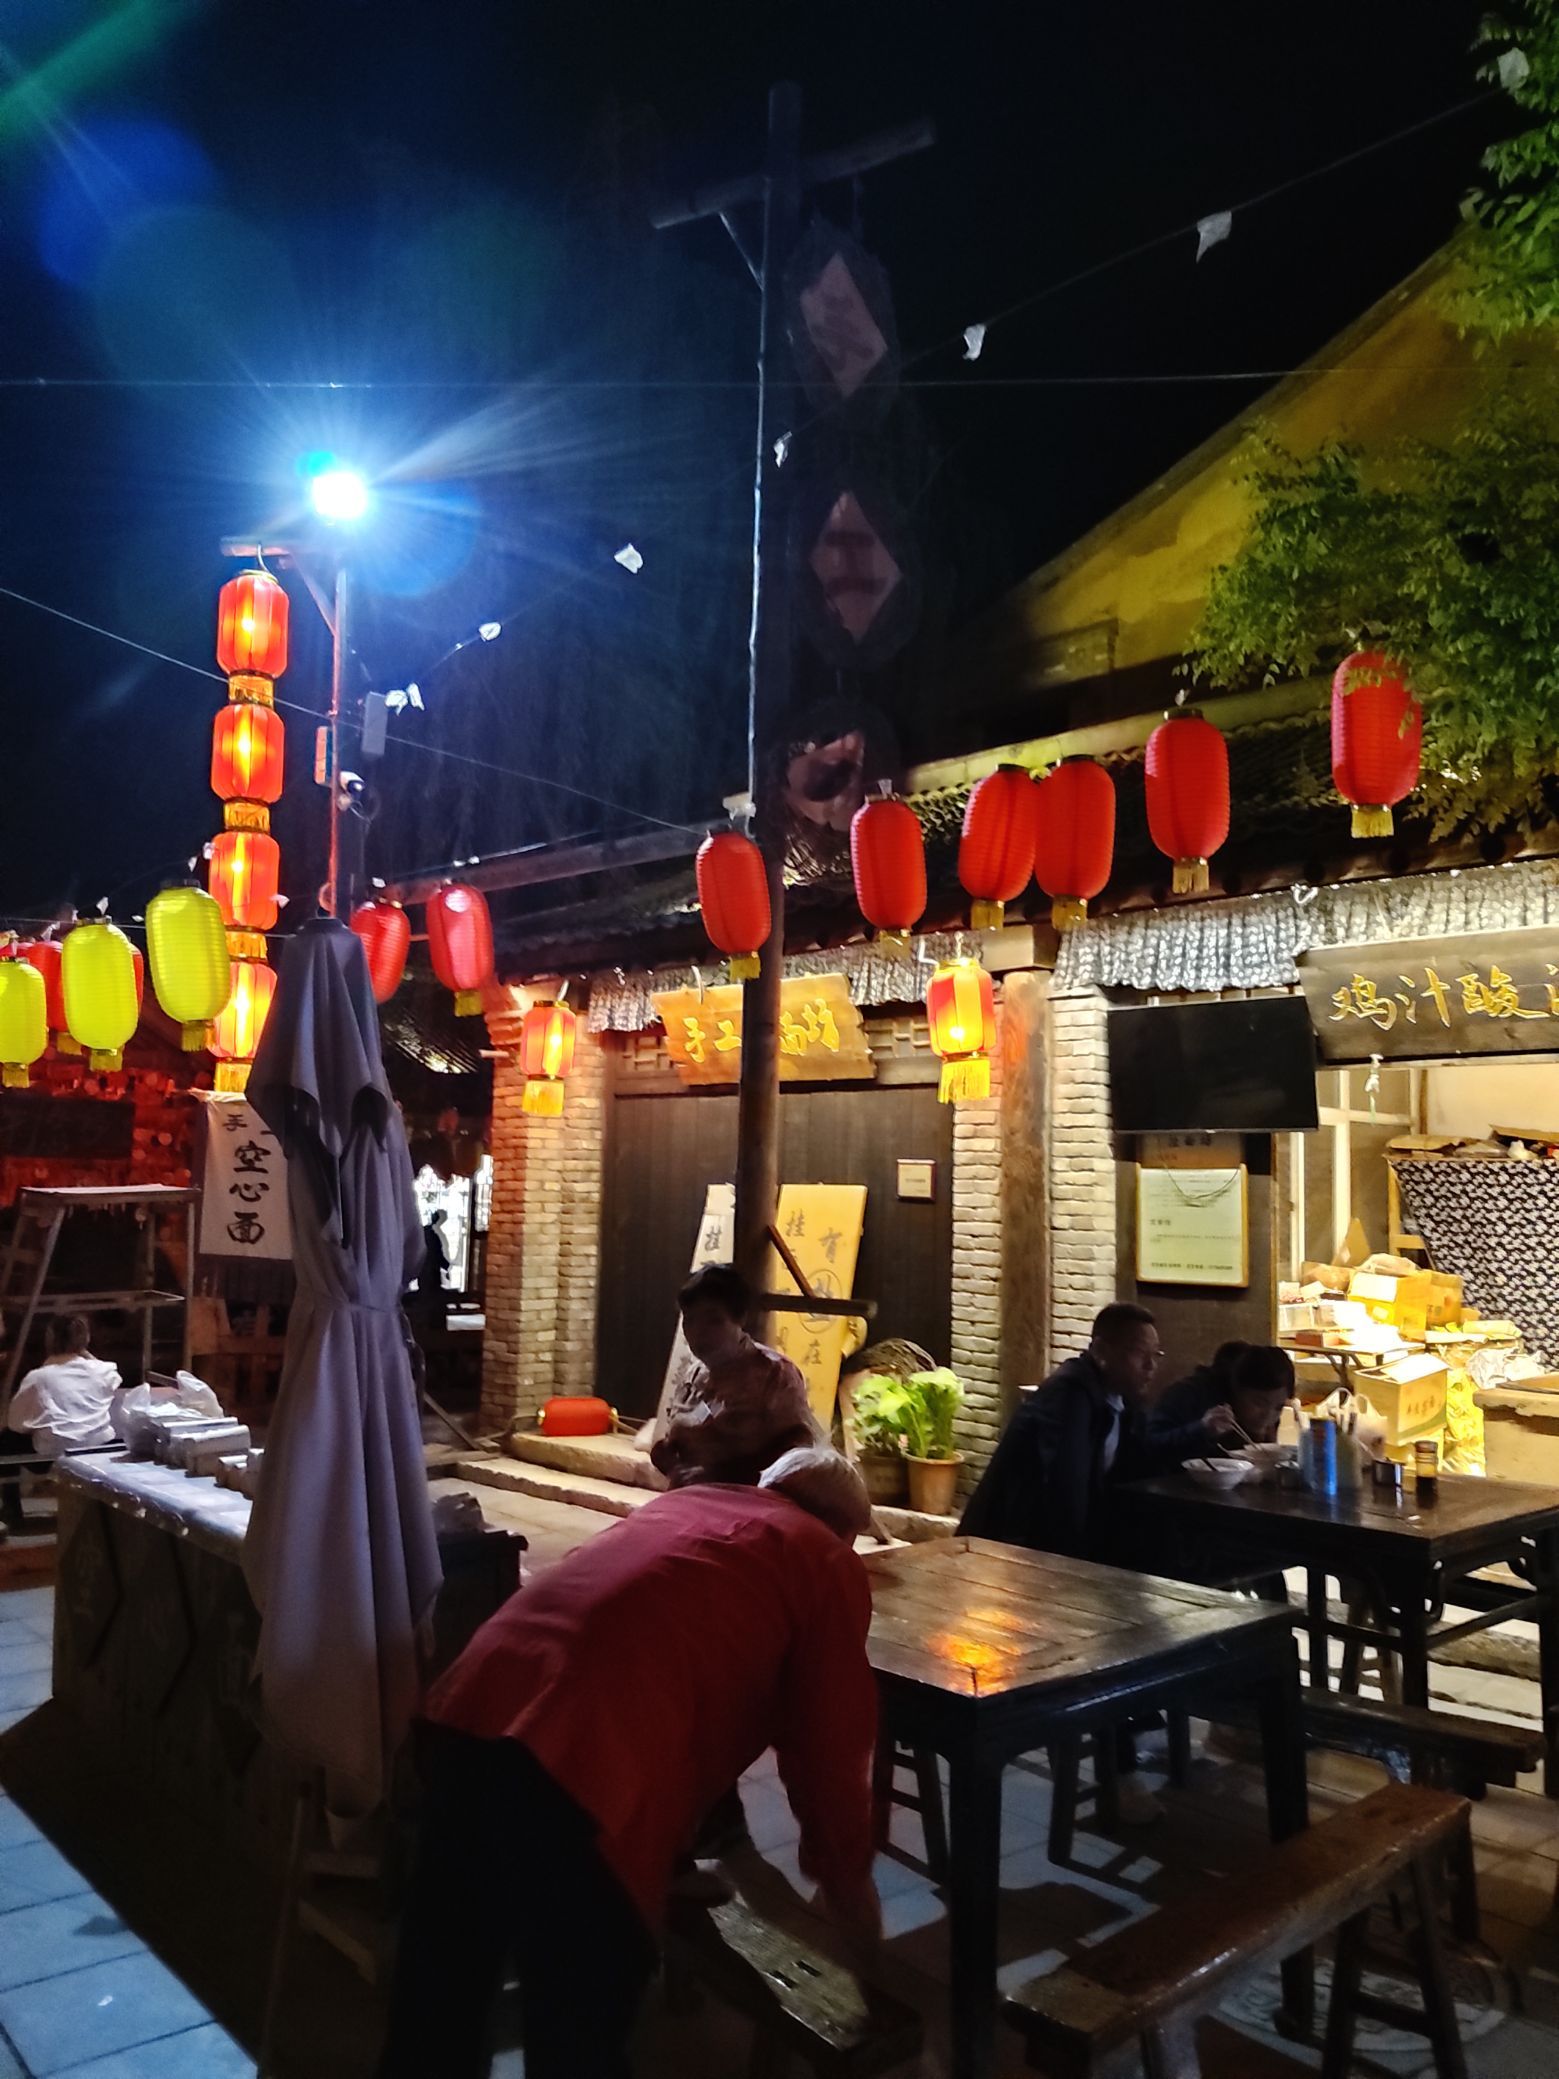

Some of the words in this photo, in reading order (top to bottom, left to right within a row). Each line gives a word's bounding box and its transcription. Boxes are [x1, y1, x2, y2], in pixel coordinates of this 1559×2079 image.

[1328, 962, 1559, 1031] 鸡汁酸
[227, 1140, 272, 1245] 空心面
